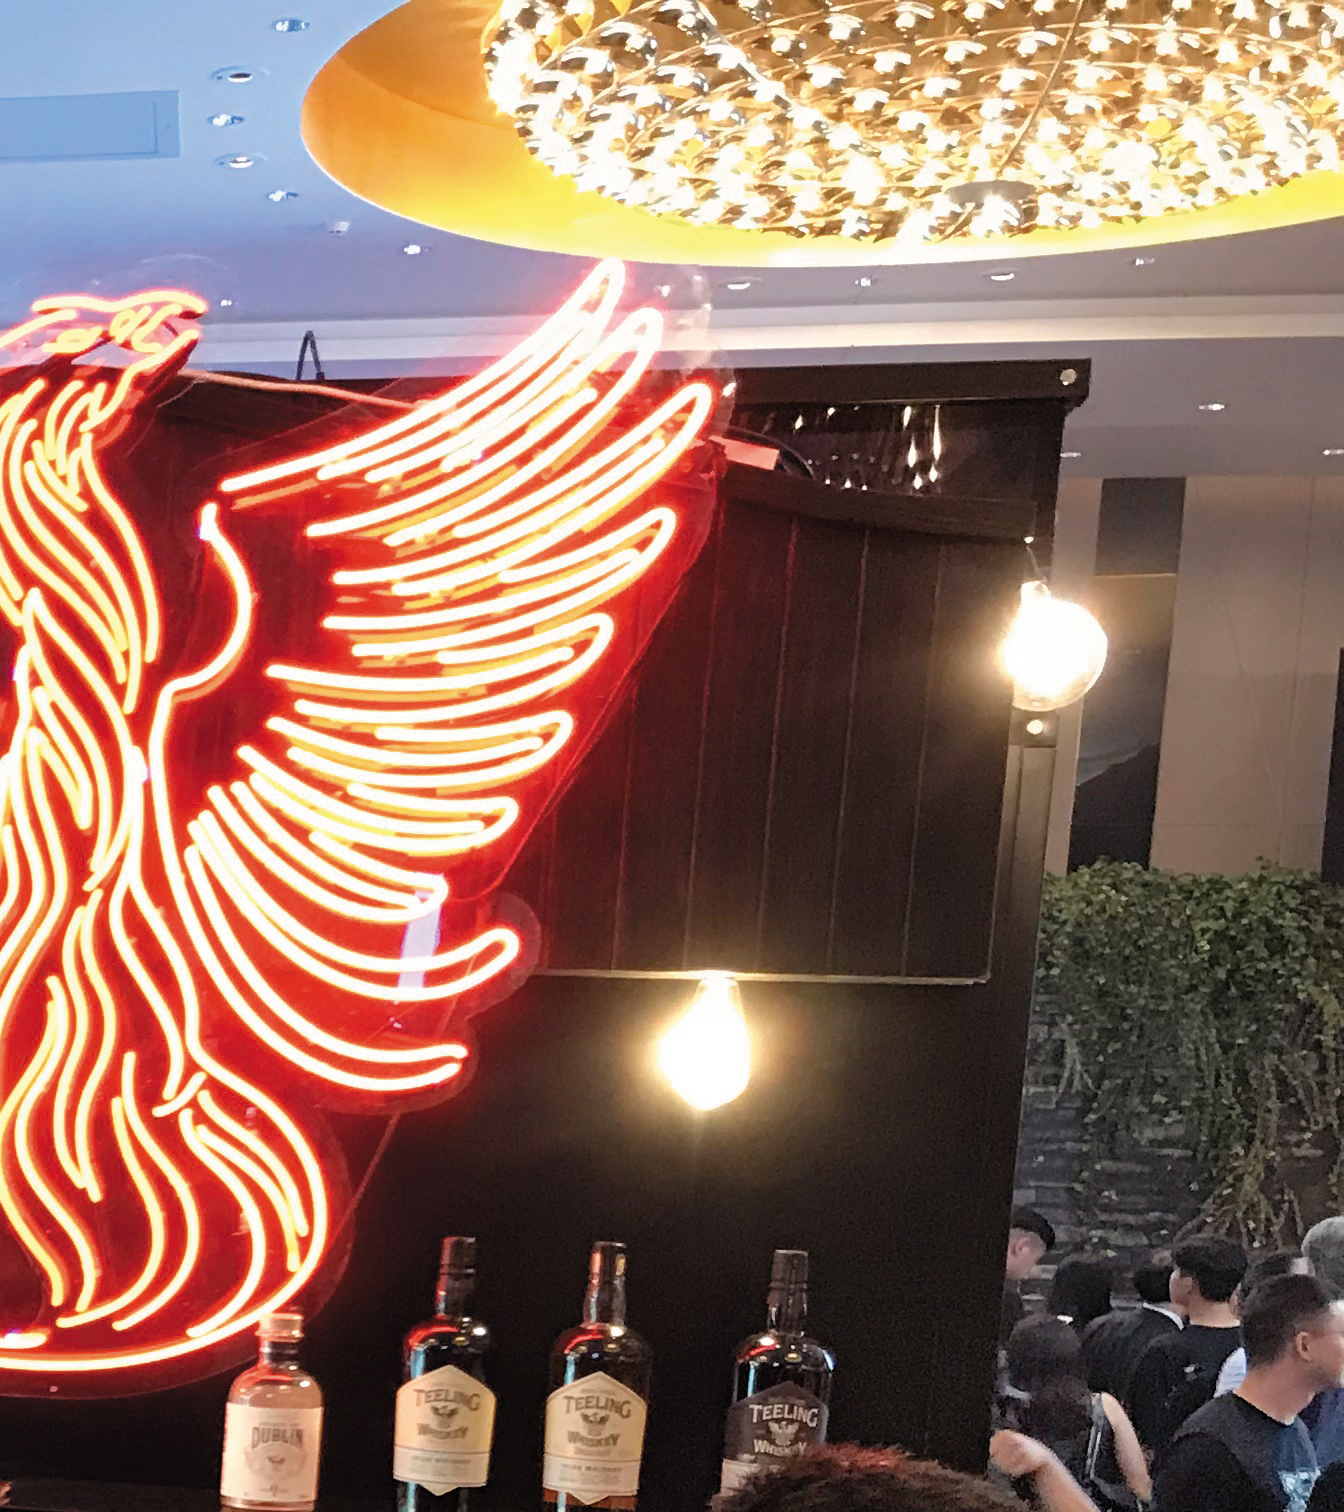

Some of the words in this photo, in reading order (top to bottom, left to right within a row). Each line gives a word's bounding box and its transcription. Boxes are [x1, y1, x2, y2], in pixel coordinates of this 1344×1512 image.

[563, 1395, 631, 1419] TEELING
[749, 1404, 818, 1428] TEELING
[252, 1427, 303, 1449] DUBLIN
